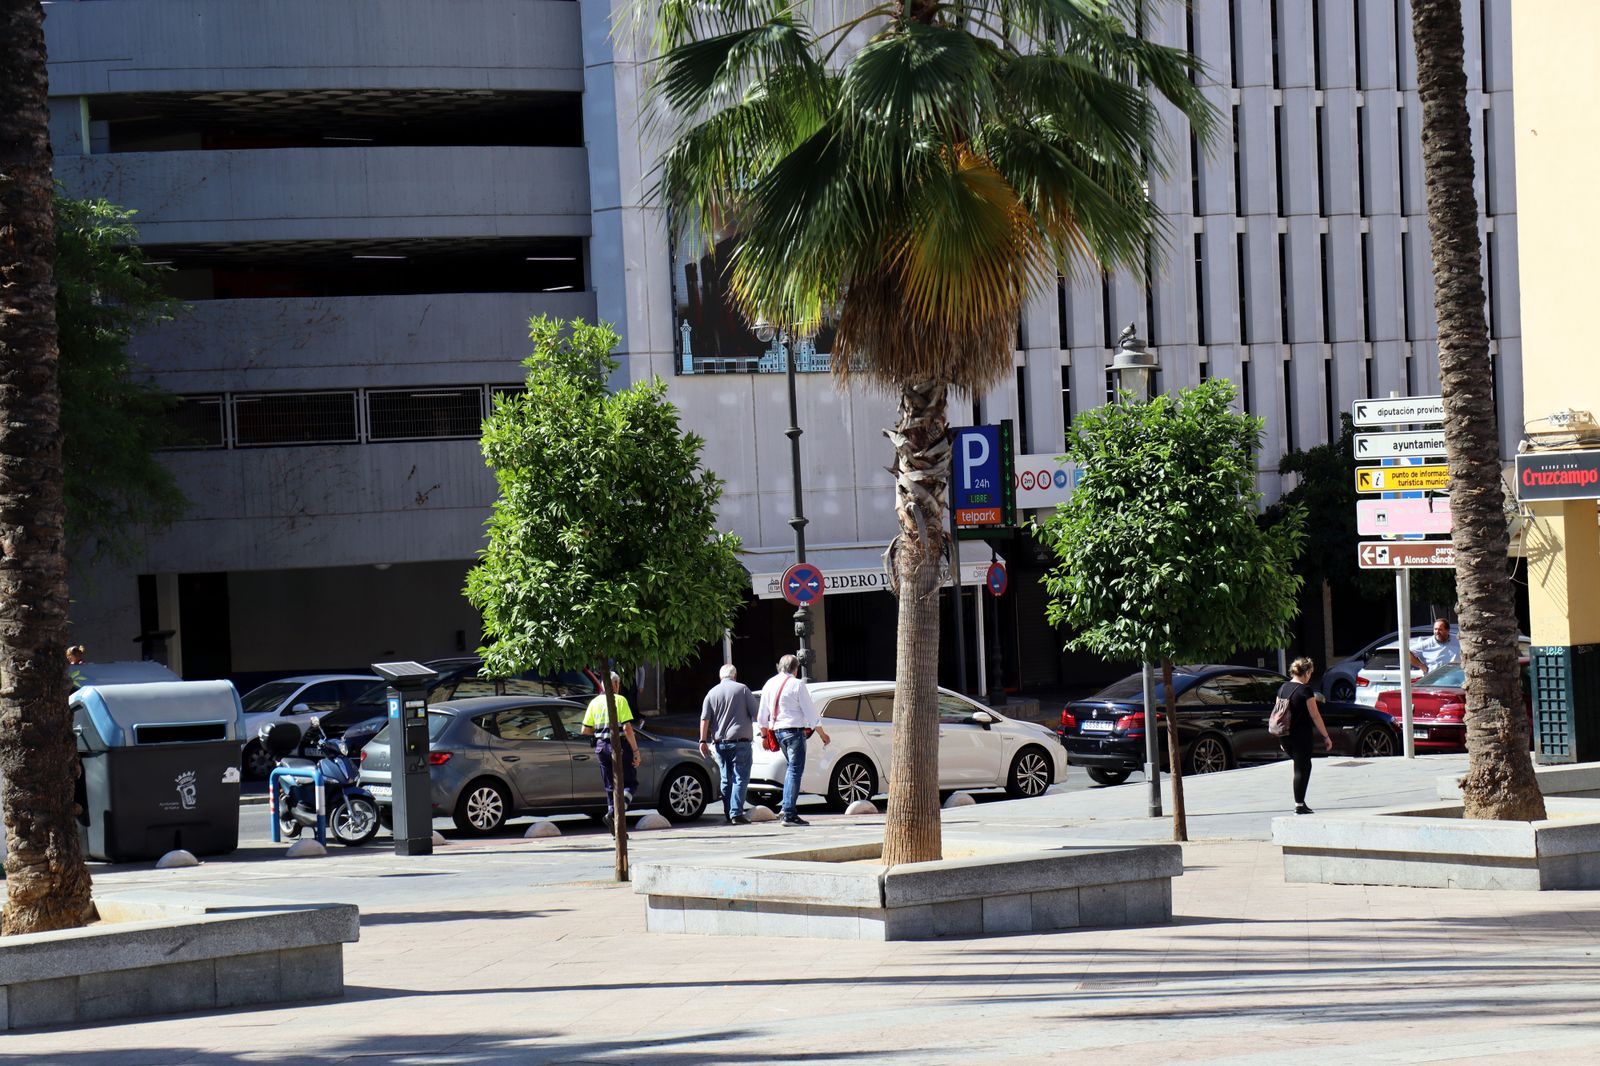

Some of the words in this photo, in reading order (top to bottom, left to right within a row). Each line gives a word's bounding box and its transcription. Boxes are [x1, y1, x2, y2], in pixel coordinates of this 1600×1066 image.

[1393, 439, 1445, 451] ayuntamien
[962, 433, 990, 489] P
[1392, 471, 1410, 479] punto
[1522, 467, 1598, 487] Cruzcampo
[974, 479, 990, 489] 24h
[970, 494, 988, 503] LIBRE
[961, 510, 995, 524] telpark
[1404, 556, 1428, 564] Alonso
[390, 701, 398, 716] P
